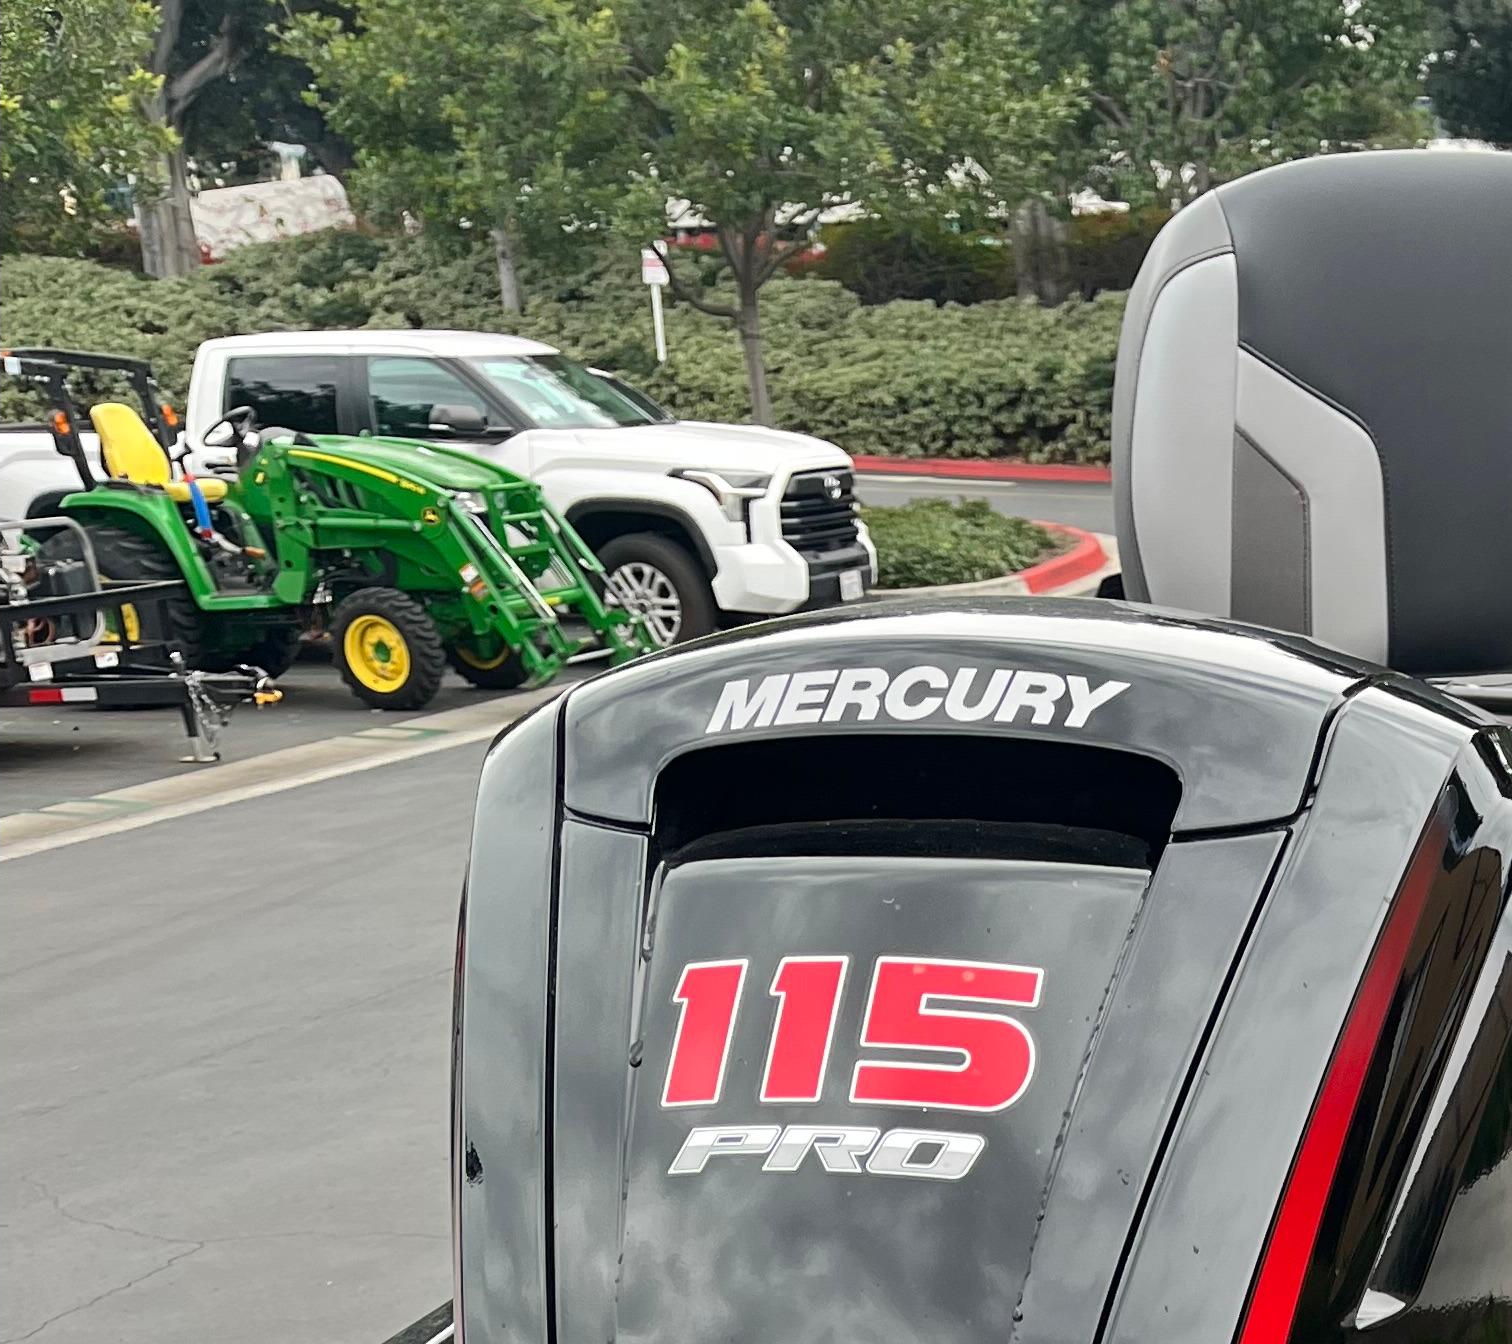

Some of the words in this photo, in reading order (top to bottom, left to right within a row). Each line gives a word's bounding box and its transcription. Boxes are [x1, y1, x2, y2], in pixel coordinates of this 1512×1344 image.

[705, 665, 1132, 735] MERCURY
[660, 955, 1045, 1113] 115
[667, 1125, 987, 1180] PRO
